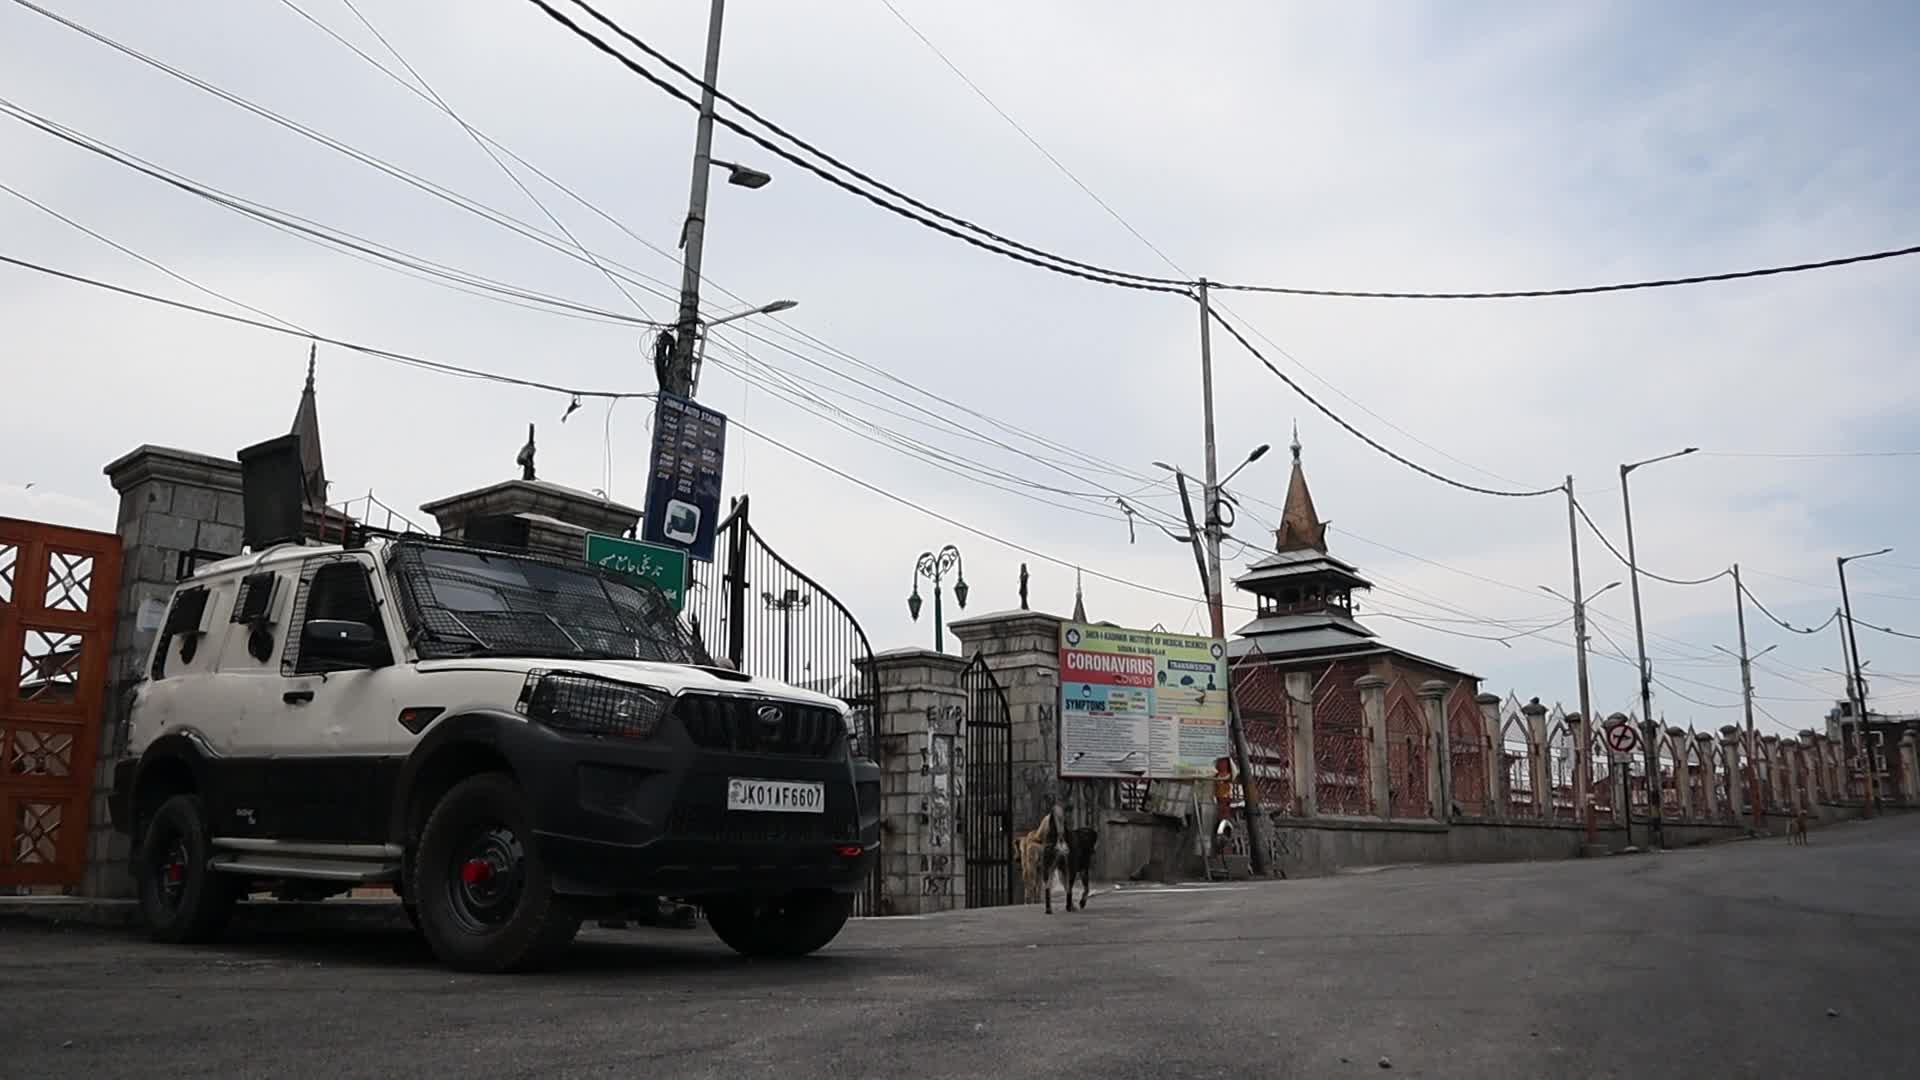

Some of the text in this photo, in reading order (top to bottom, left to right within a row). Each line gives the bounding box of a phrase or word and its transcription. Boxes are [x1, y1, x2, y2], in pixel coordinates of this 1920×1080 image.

[701, 411, 721, 426] STAND
[1067, 653, 1153, 675] CORONAVIRUS
[1065, 699, 1106, 711] SYMPTOMS
